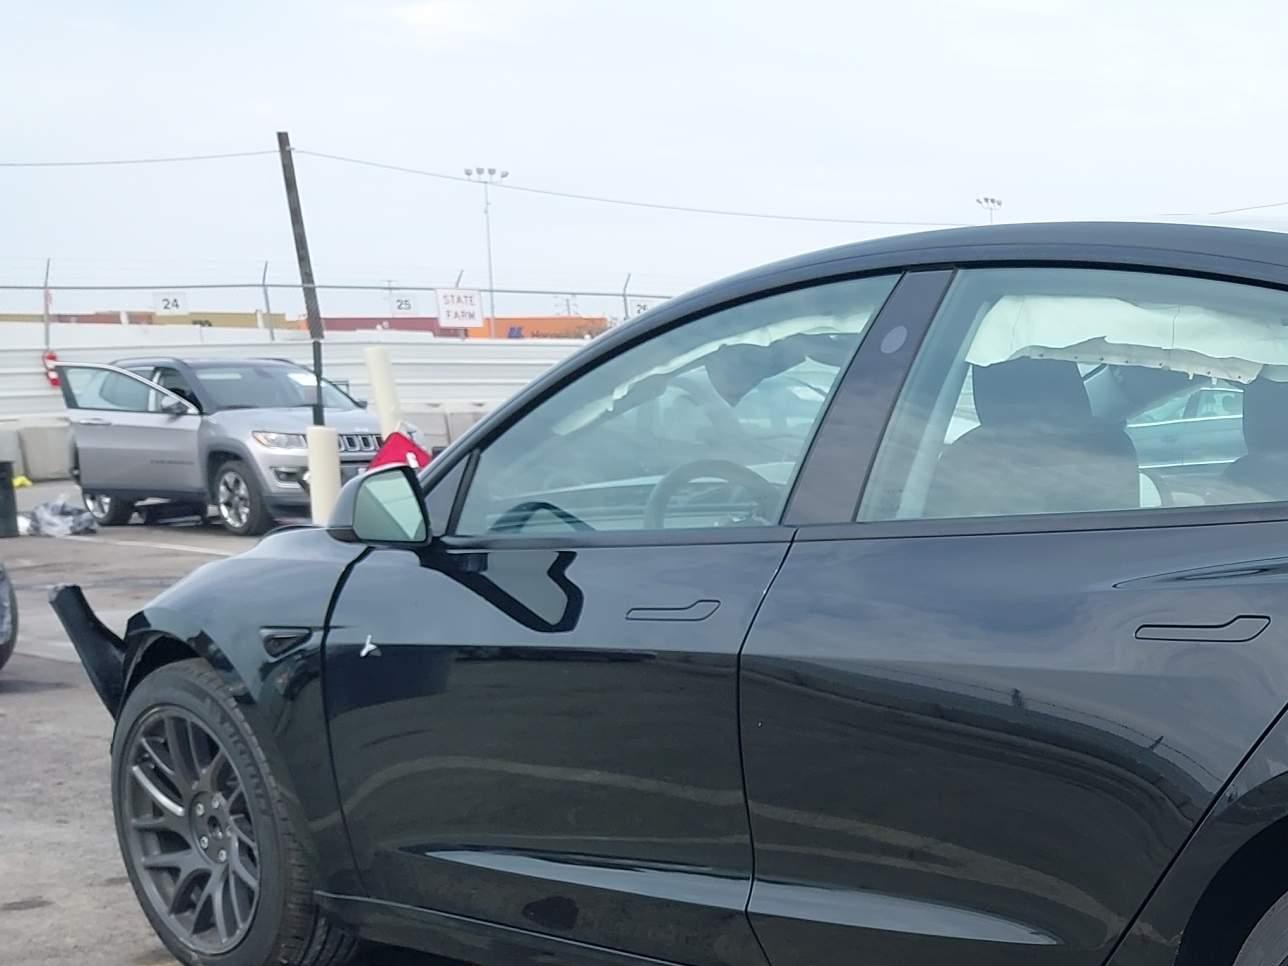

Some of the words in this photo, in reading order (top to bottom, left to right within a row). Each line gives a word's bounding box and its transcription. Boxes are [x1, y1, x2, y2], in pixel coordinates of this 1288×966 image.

[161, 298, 180, 310] 24
[396, 299, 412, 311] 25
[442, 294, 477, 305] STATE
[446, 310, 476, 320] FARM
